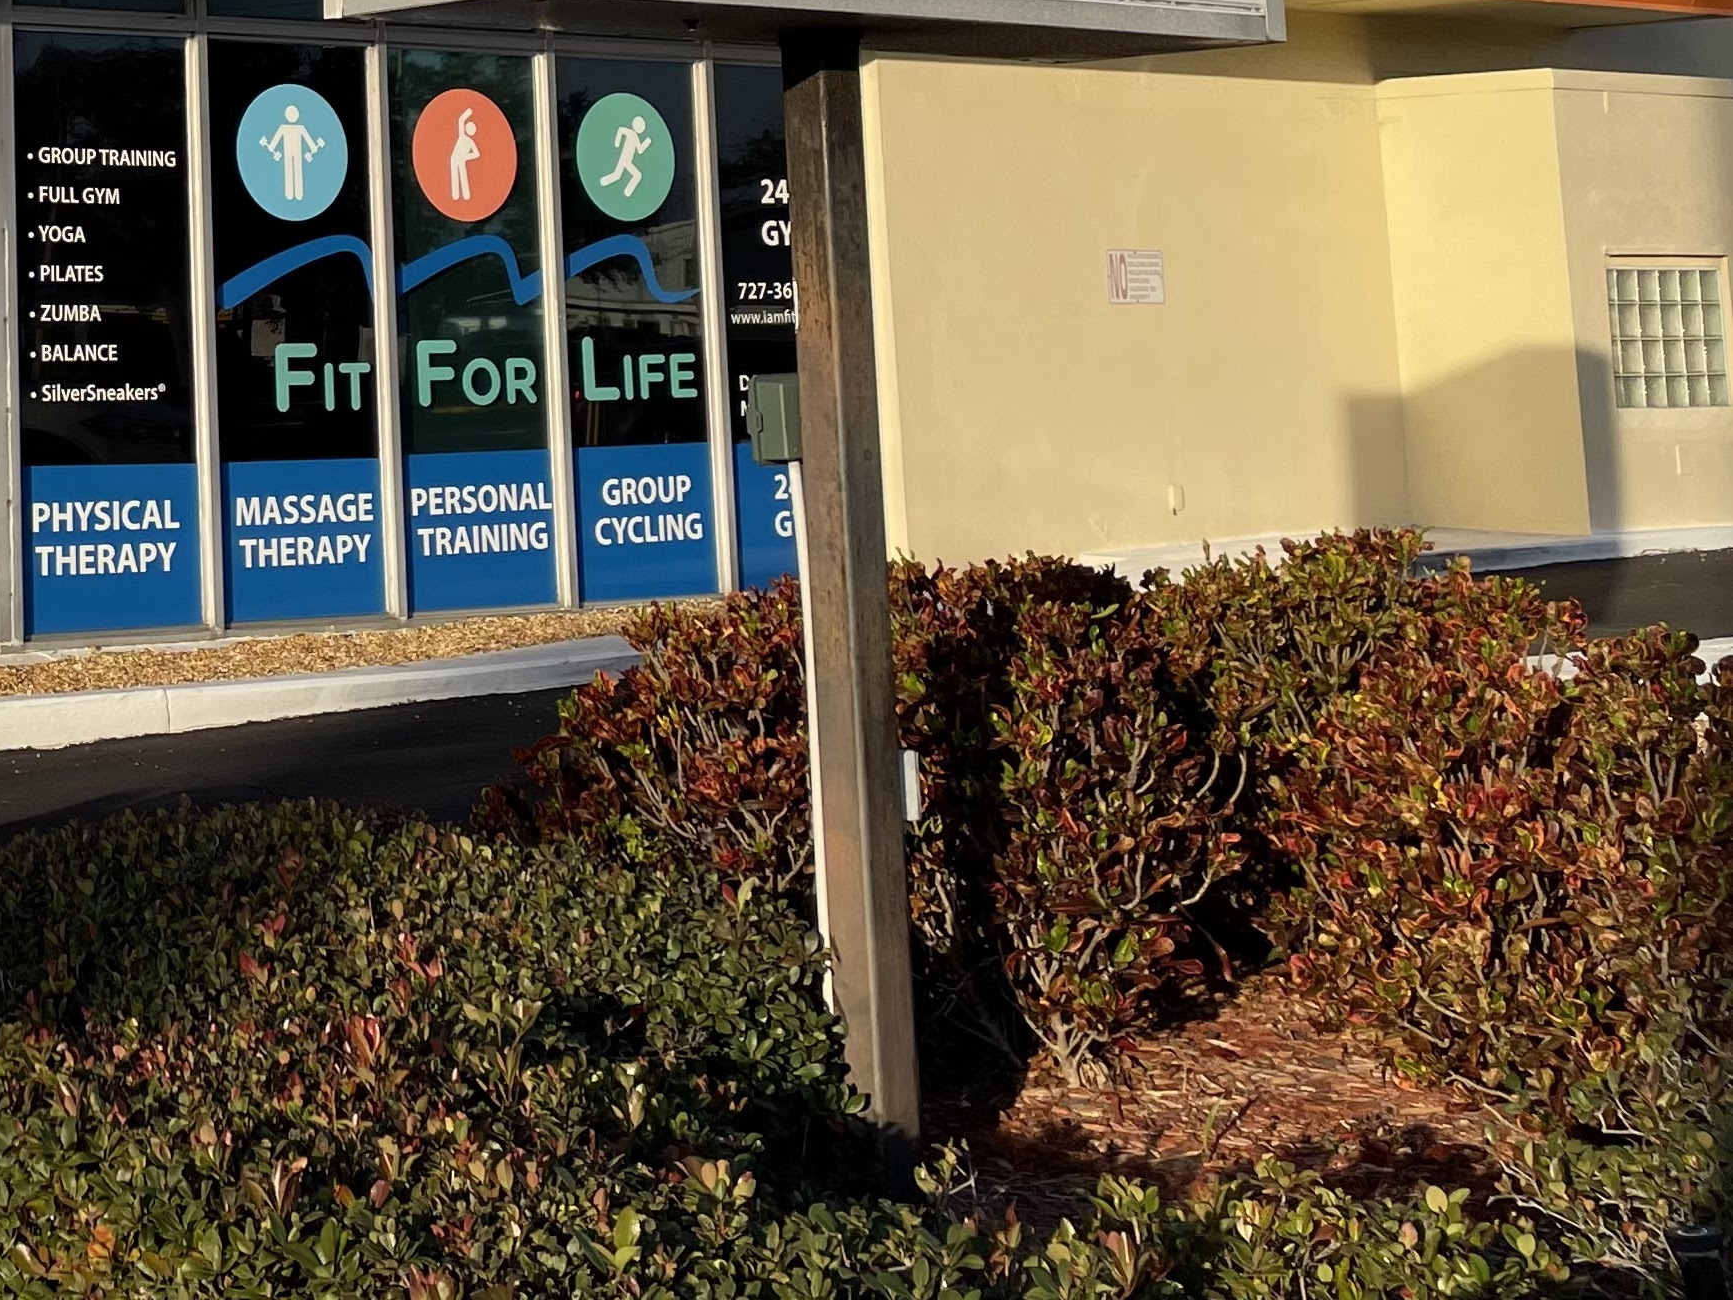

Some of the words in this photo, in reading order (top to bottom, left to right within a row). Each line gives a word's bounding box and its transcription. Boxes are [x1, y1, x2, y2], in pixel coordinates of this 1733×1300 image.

[38, 147, 97, 165] GROUP
[99, 149, 176, 168] TRAINING
[39, 186, 79, 203] FULL
[82, 188, 120, 204] GYM
[760, 178, 790, 204] 24
[38, 225, 86, 243] YOGA
[761, 220, 792, 246] GY
[40, 265, 104, 282] PILATES
[40, 304, 101, 322] ZUMBA
[41, 344, 118, 362] BALANCE
[275, 343, 371, 413] FIT
[416, 339, 537, 407] FOR
[581, 336, 698, 402] LIFE
[411, 482, 553, 517] PERSONAL
[601, 475, 691, 507] GROUP
[32, 499, 180, 533] PHYSICAL
[235, 492, 374, 527] MASSAGE
[417, 521, 549, 557] TRAINING
[594, 512, 703, 546] CYCLING
[35, 542, 177, 577] THERAPY
[239, 534, 372, 569] THERAPY
